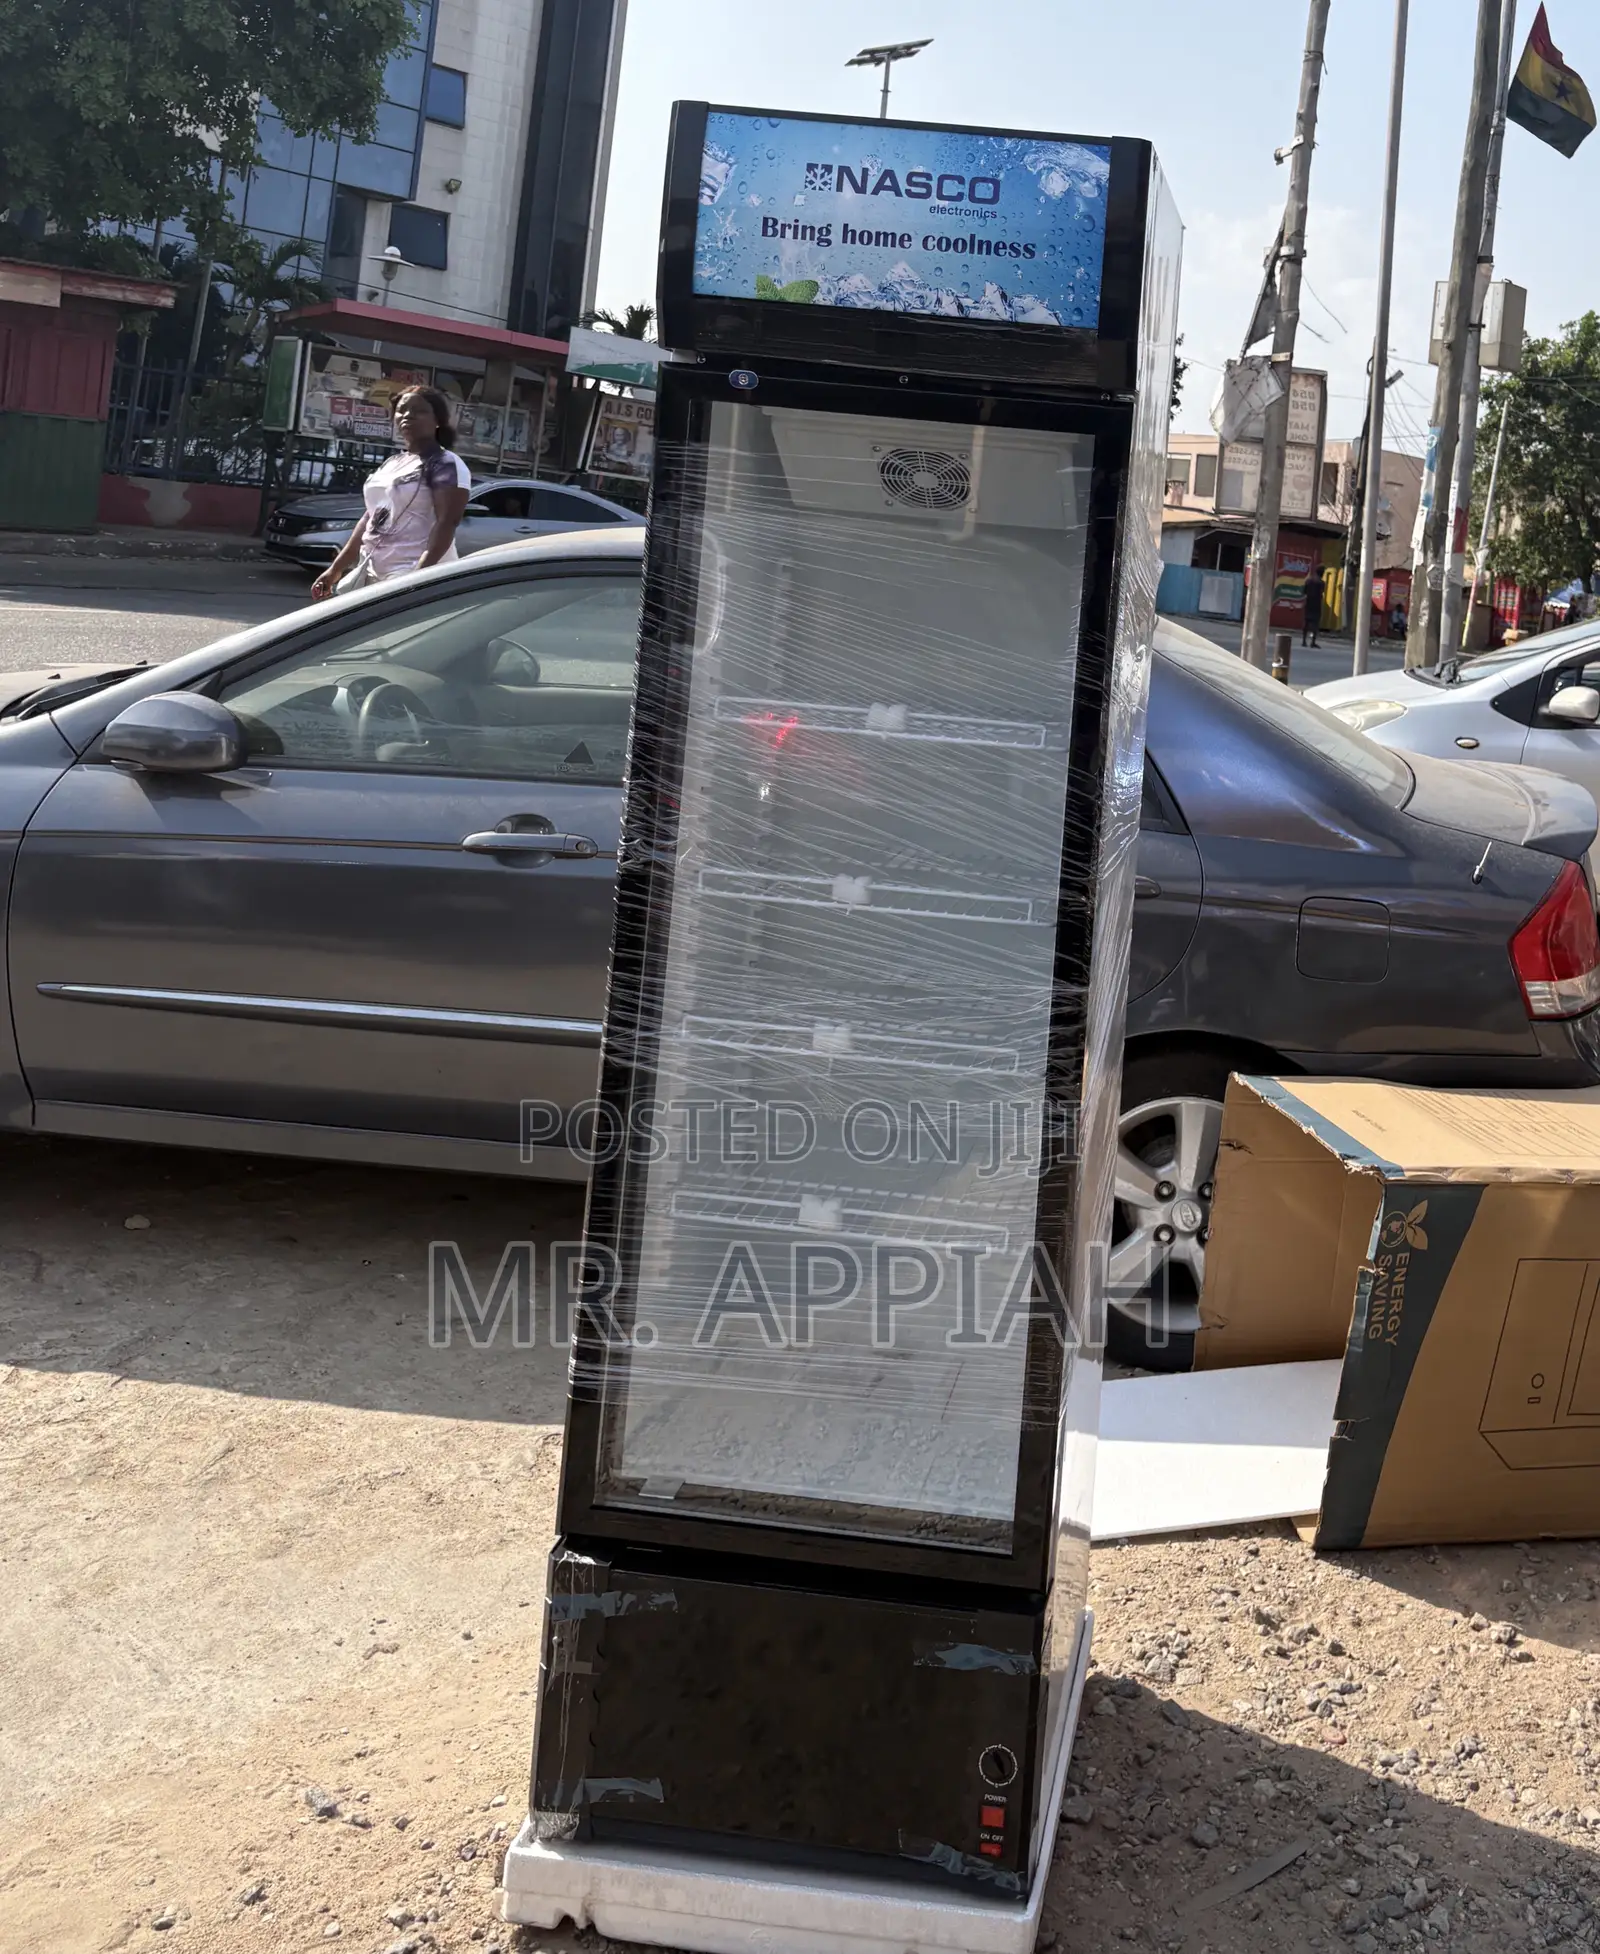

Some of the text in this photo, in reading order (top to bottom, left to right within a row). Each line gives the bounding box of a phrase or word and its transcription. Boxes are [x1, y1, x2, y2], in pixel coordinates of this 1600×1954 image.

[835, 164, 1000, 205] NASCO
[929, 203, 997, 219] electronics
[761, 216, 1036, 260] Bring home coolness
[1368, 1254, 1392, 1340] SAVING
[1384, 1252, 1410, 1346] ENERGY
[984, 1793, 1007, 1803] POWER
[980, 1832, 1004, 1842] ON OFF
